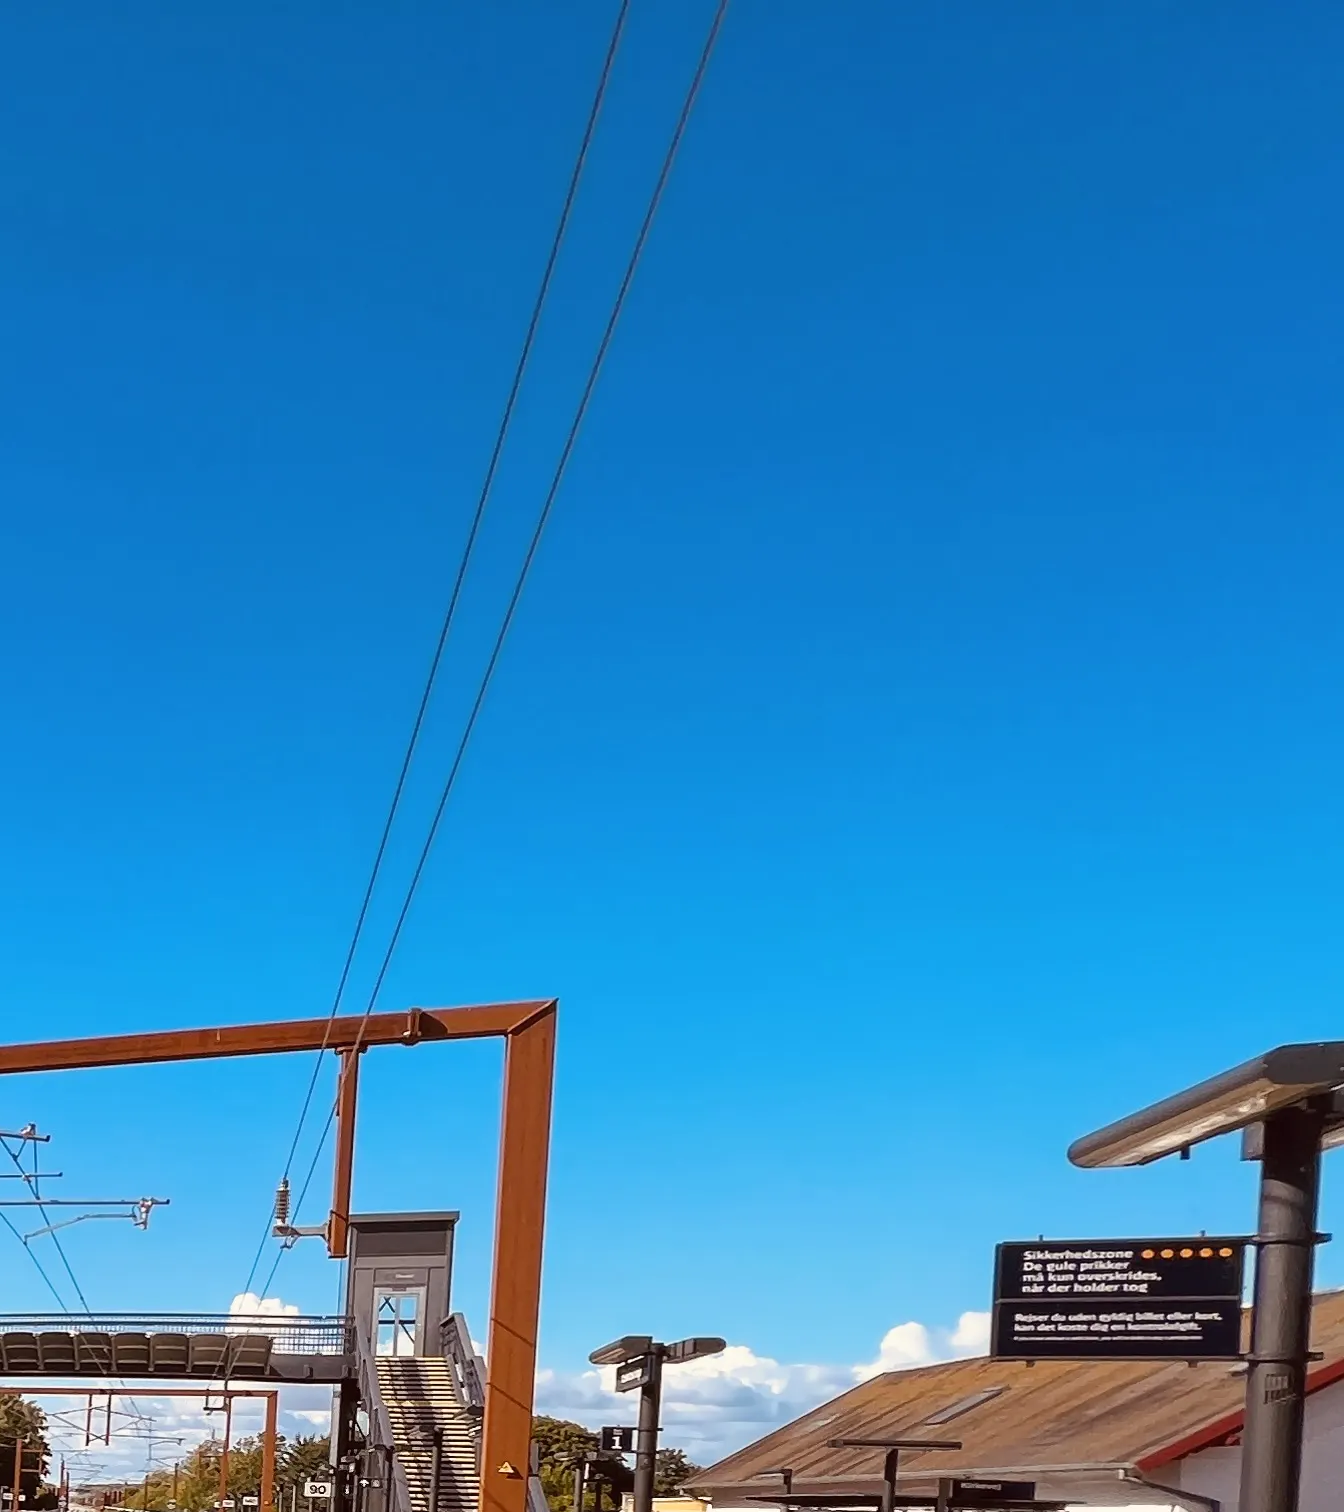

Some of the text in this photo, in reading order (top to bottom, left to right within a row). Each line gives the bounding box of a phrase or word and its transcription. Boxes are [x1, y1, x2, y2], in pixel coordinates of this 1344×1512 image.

[1023, 1250, 1134, 1261] Sikkerhedszone
[1023, 1260, 1130, 1272] De gule prikker
[1022, 1272, 1045, 1282] må
[1048, 1272, 1074, 1281] kun
[1022, 1283, 1148, 1294] når der holder tog
[611, 1436, 623, 1450] 1
[310, 1485, 326, 1494] 90
